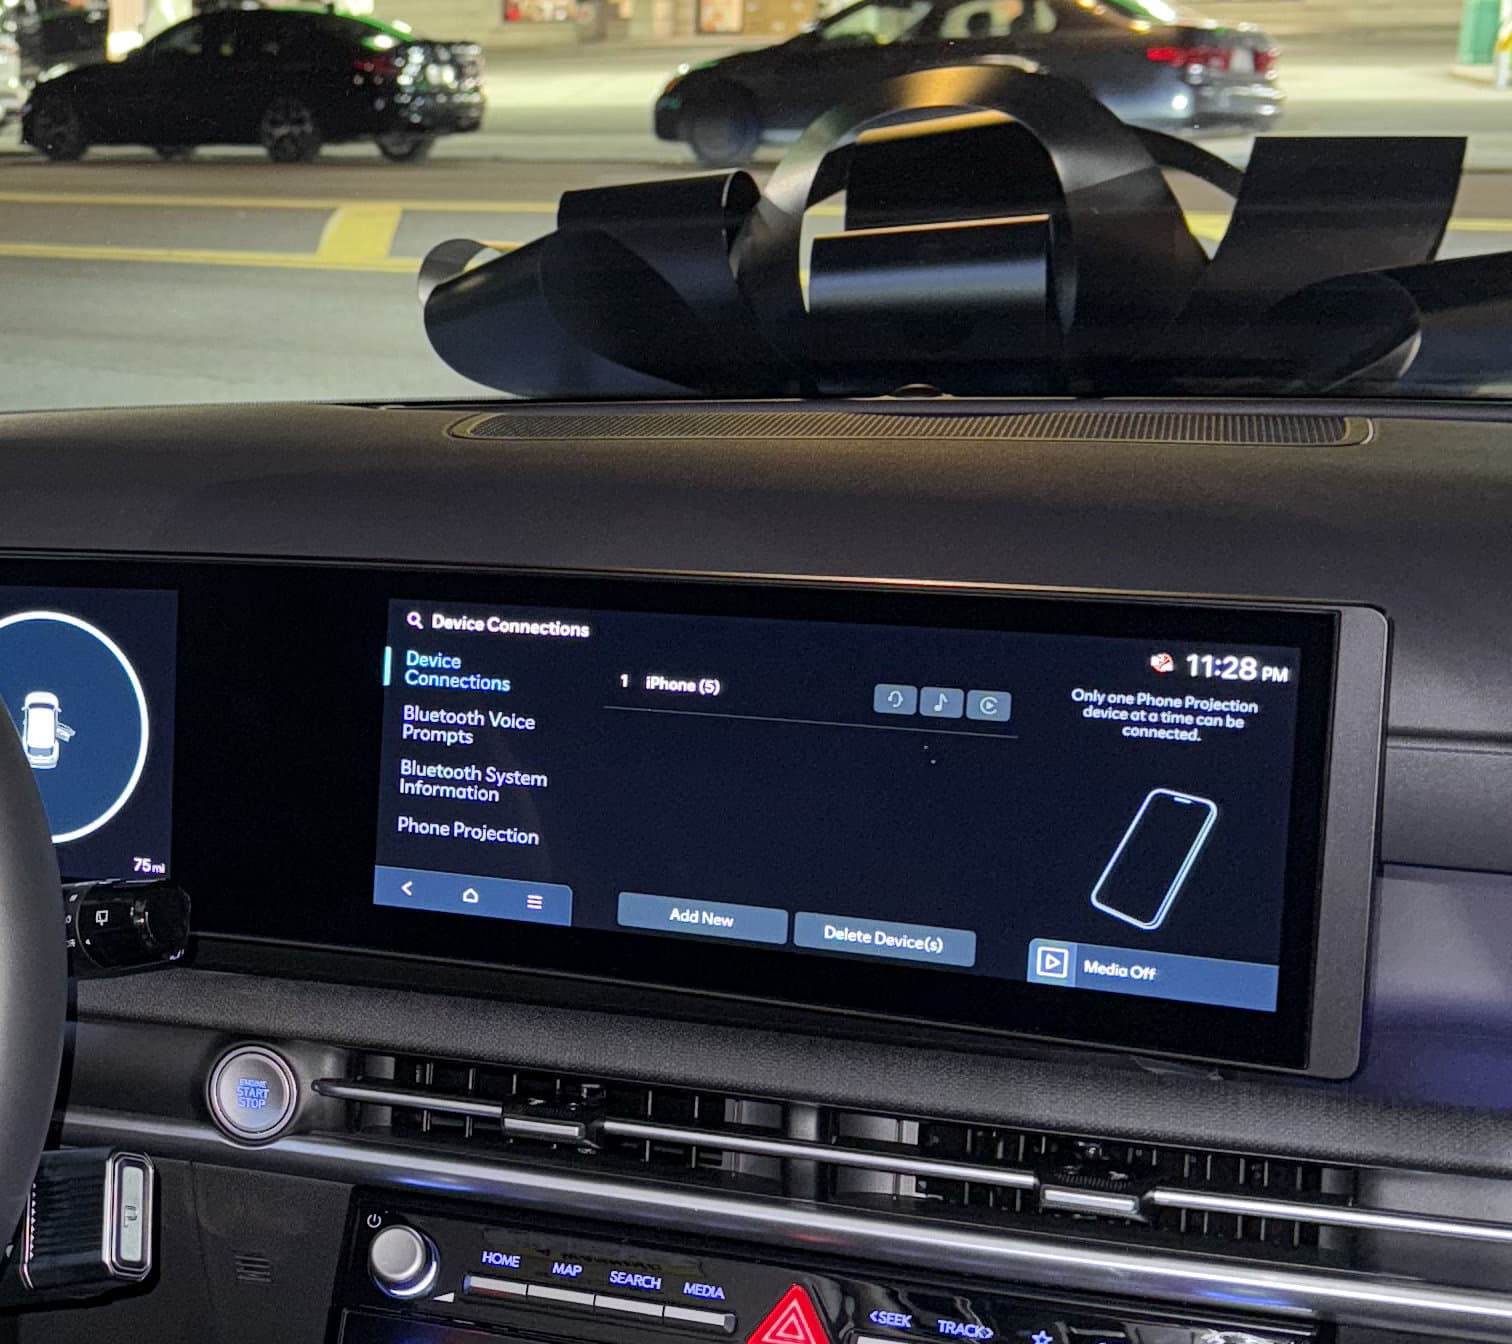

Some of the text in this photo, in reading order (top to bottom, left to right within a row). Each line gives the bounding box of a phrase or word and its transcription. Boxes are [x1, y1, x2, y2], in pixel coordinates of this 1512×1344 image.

[432, 613, 590, 638] Device Connections
[406, 650, 462, 669] Device
[1187, 653, 1289, 683] 11:28 PM
[405, 669, 511, 692] Connections
[620, 674, 720, 696] 1 iPhone (5)
[1071, 688, 1259, 714] Only one Phone Projection
[403, 704, 536, 730] Bluetooth Voice
[1083, 705, 1245, 729] device at a time can be
[402, 724, 474, 747] Prompts
[1122, 725, 1202, 742] connected.
[400, 759, 548, 788] Bluetooth System
[399, 778, 500, 803] Information
[397, 815, 540, 845] Phone Projection
[669, 907, 734, 928] Add New
[824, 924, 944, 954] Delete Device(s)
[1084, 959, 1157, 981] Media Off
[236, 1087, 269, 1099] START
[238, 1098, 266, 1109] STOP
[481, 1250, 521, 1269] HOME
[552, 1262, 583, 1278] MAP
[609, 1270, 662, 1290] SEARCH
[683, 1281, 726, 1300] MEDIA
